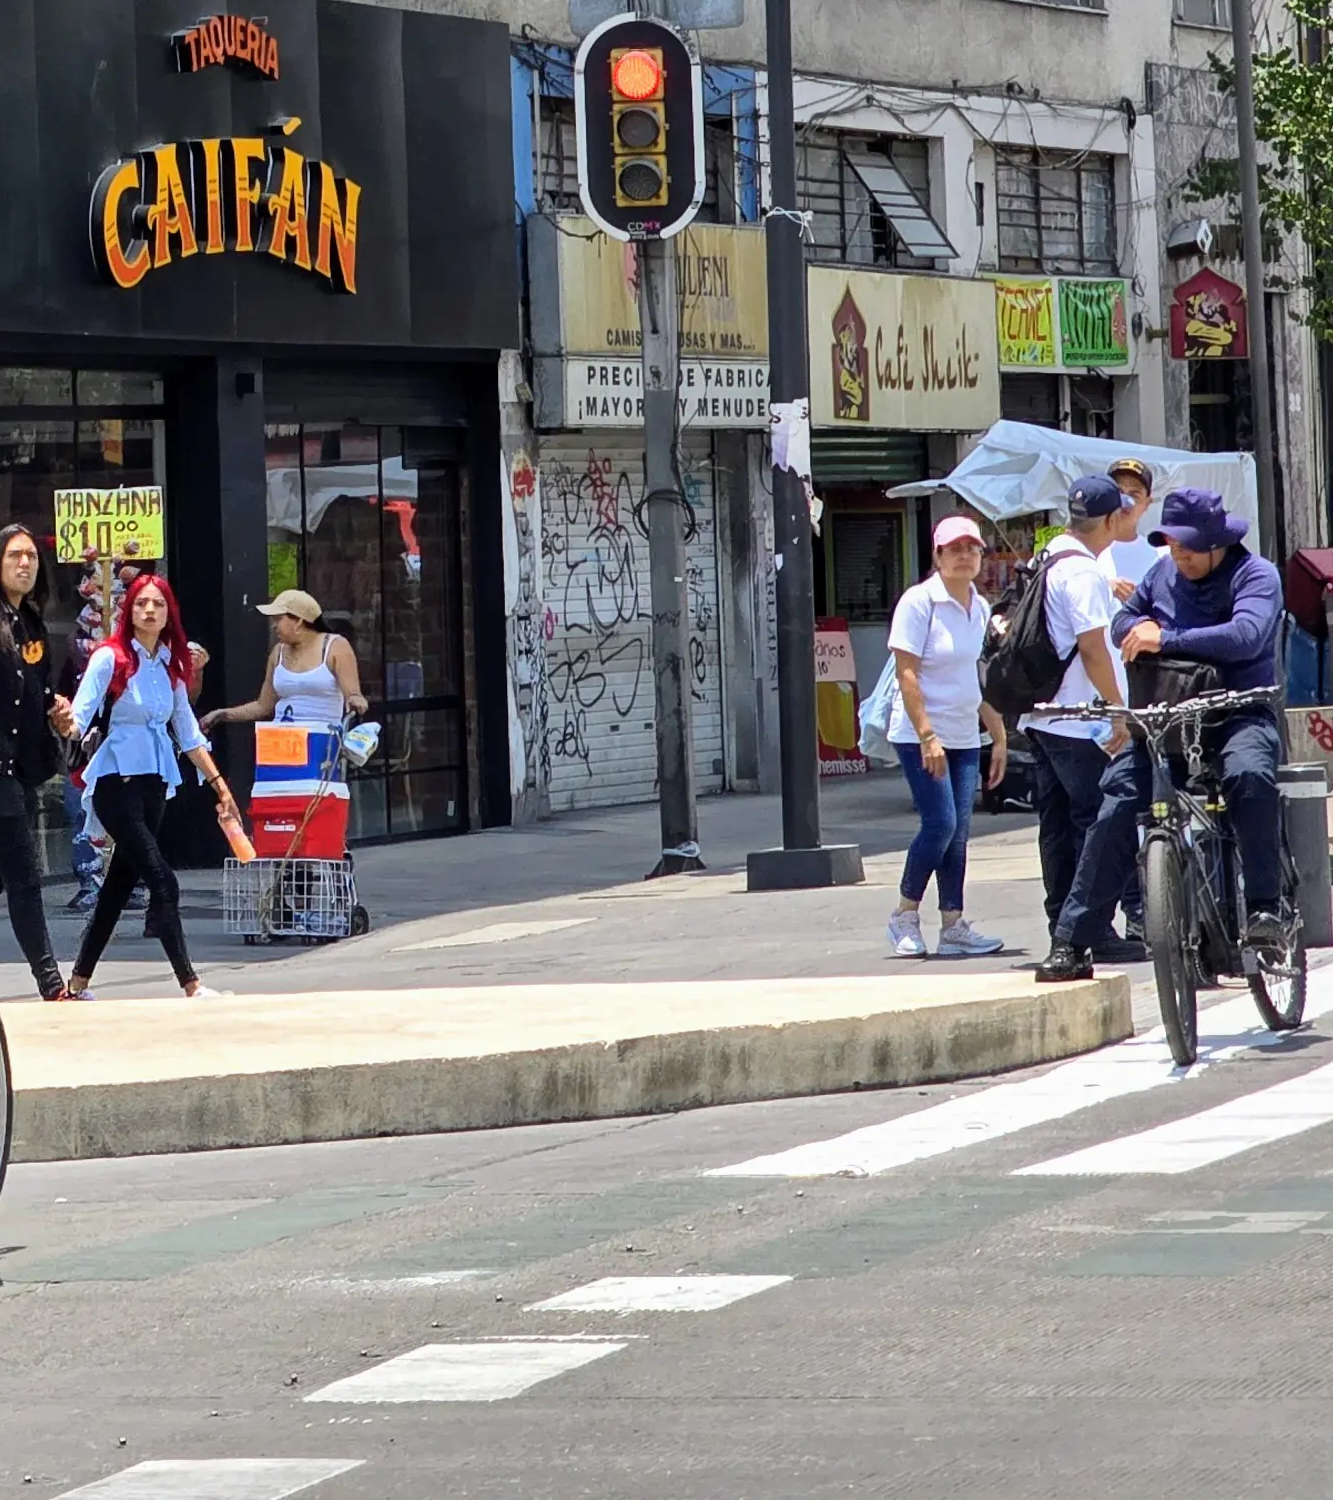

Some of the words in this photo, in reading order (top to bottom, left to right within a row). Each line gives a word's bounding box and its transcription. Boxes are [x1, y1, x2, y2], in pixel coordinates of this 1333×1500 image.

[104, 116, 362, 295] CAIFÁN
[627, 221, 661, 231] CDMX
[606, 328, 642, 347] CAMIS
[710, 332, 717, 349] Y
[587, 365, 641, 387] PRECI
[579, 396, 644, 420] ¡MAYOR
[57, 489, 161, 518] MANZANA
[818, 759, 867, 775] hemisse
